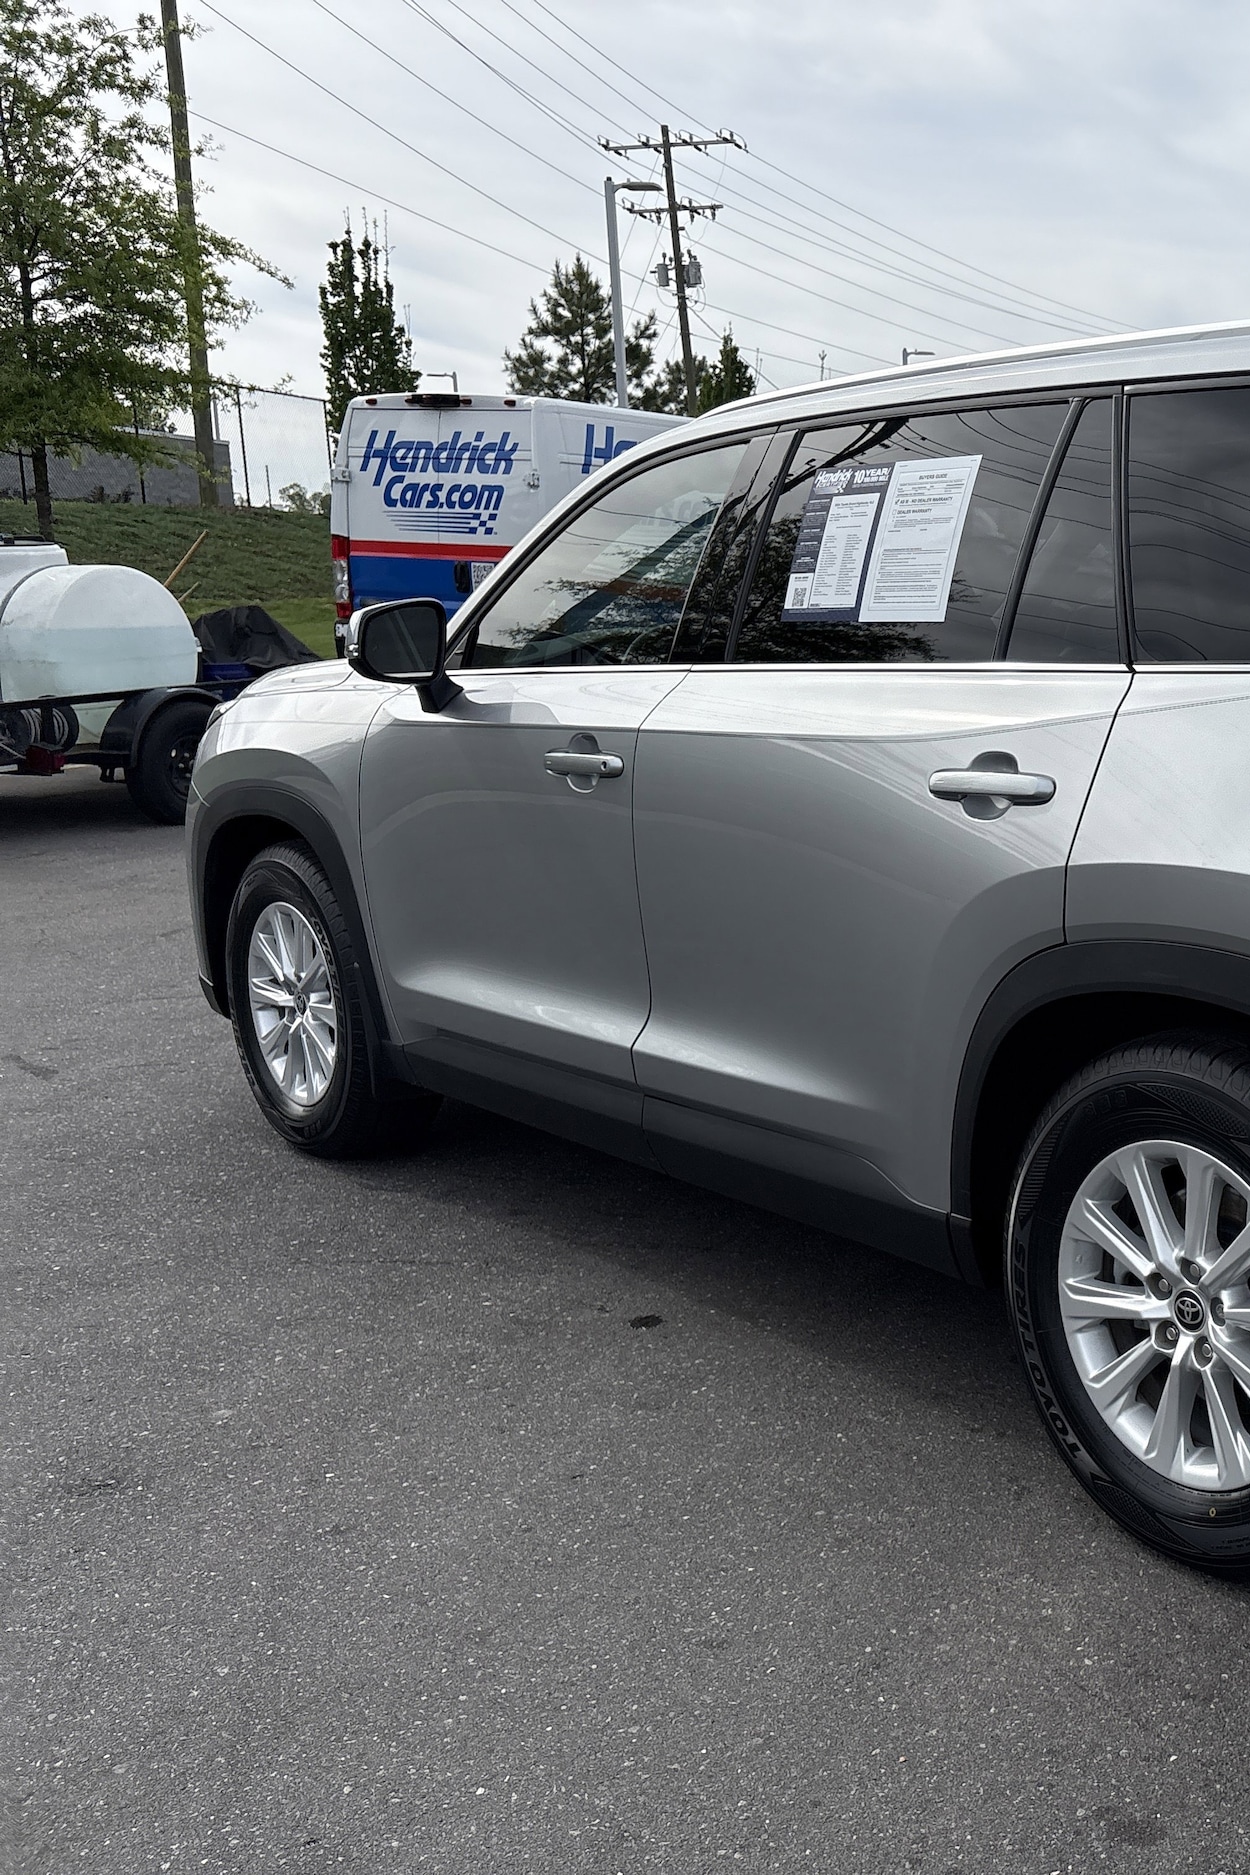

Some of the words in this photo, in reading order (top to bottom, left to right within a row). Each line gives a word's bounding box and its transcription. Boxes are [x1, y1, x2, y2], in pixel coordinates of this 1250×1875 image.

[359, 430, 520, 487] Hendrick
[814, 468, 853, 488] Hendrick
[853, 469, 865, 484] 10
[383, 475, 505, 511] Cars.com
[1014, 1243, 1037, 1355] TIRES
[1027, 1360, 1082, 1460] TOYO
